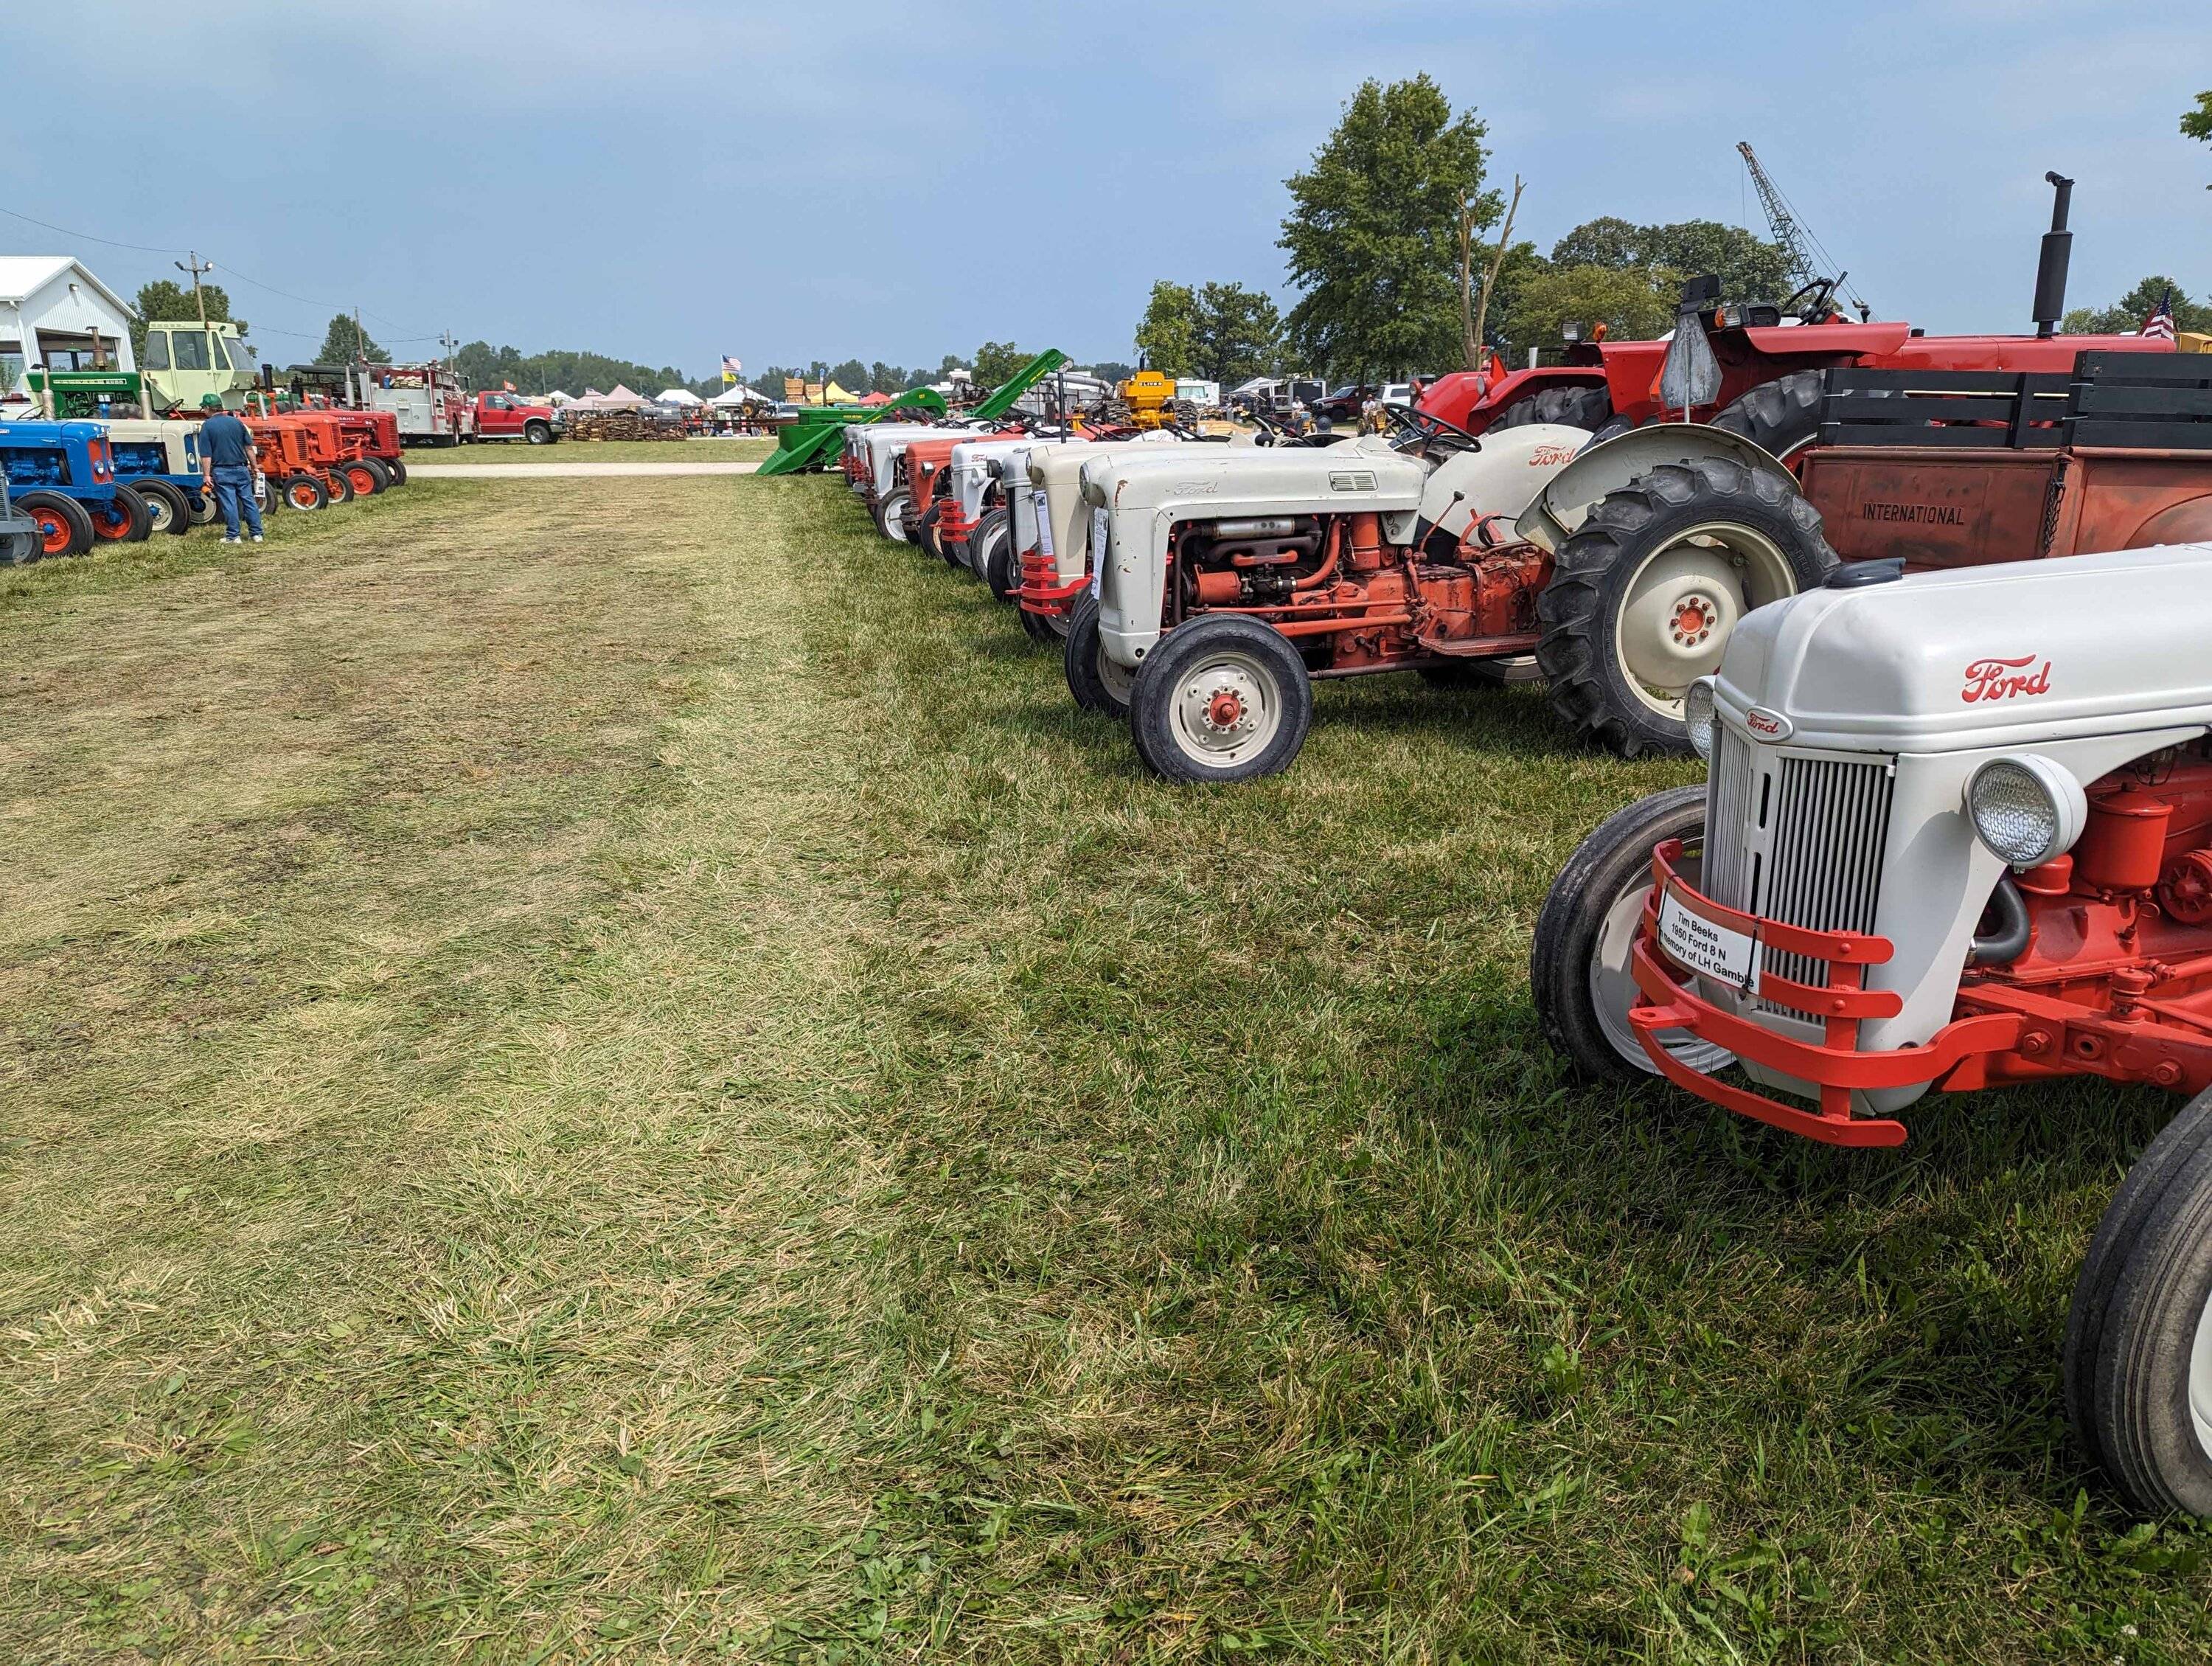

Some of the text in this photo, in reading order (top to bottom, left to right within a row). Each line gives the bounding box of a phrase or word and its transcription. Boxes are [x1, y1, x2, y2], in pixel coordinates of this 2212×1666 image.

[971, 454, 988, 462] Ford
[1528, 445, 1576, 466] Ford
[1174, 481, 1219, 496] Ford
[1863, 503, 1965, 526] INTERNATIONAL
[1961, 653, 2052, 703] Ford
[1747, 712, 1778, 734] Ford
[1678, 912, 1719, 942] Tim Beeks
[1663, 933, 1687, 957] memory
[1688, 950, 1697, 962] of
[1698, 954, 1711, 969] LH
[1672, 923, 1726, 961] 1950 Ford 8 N
